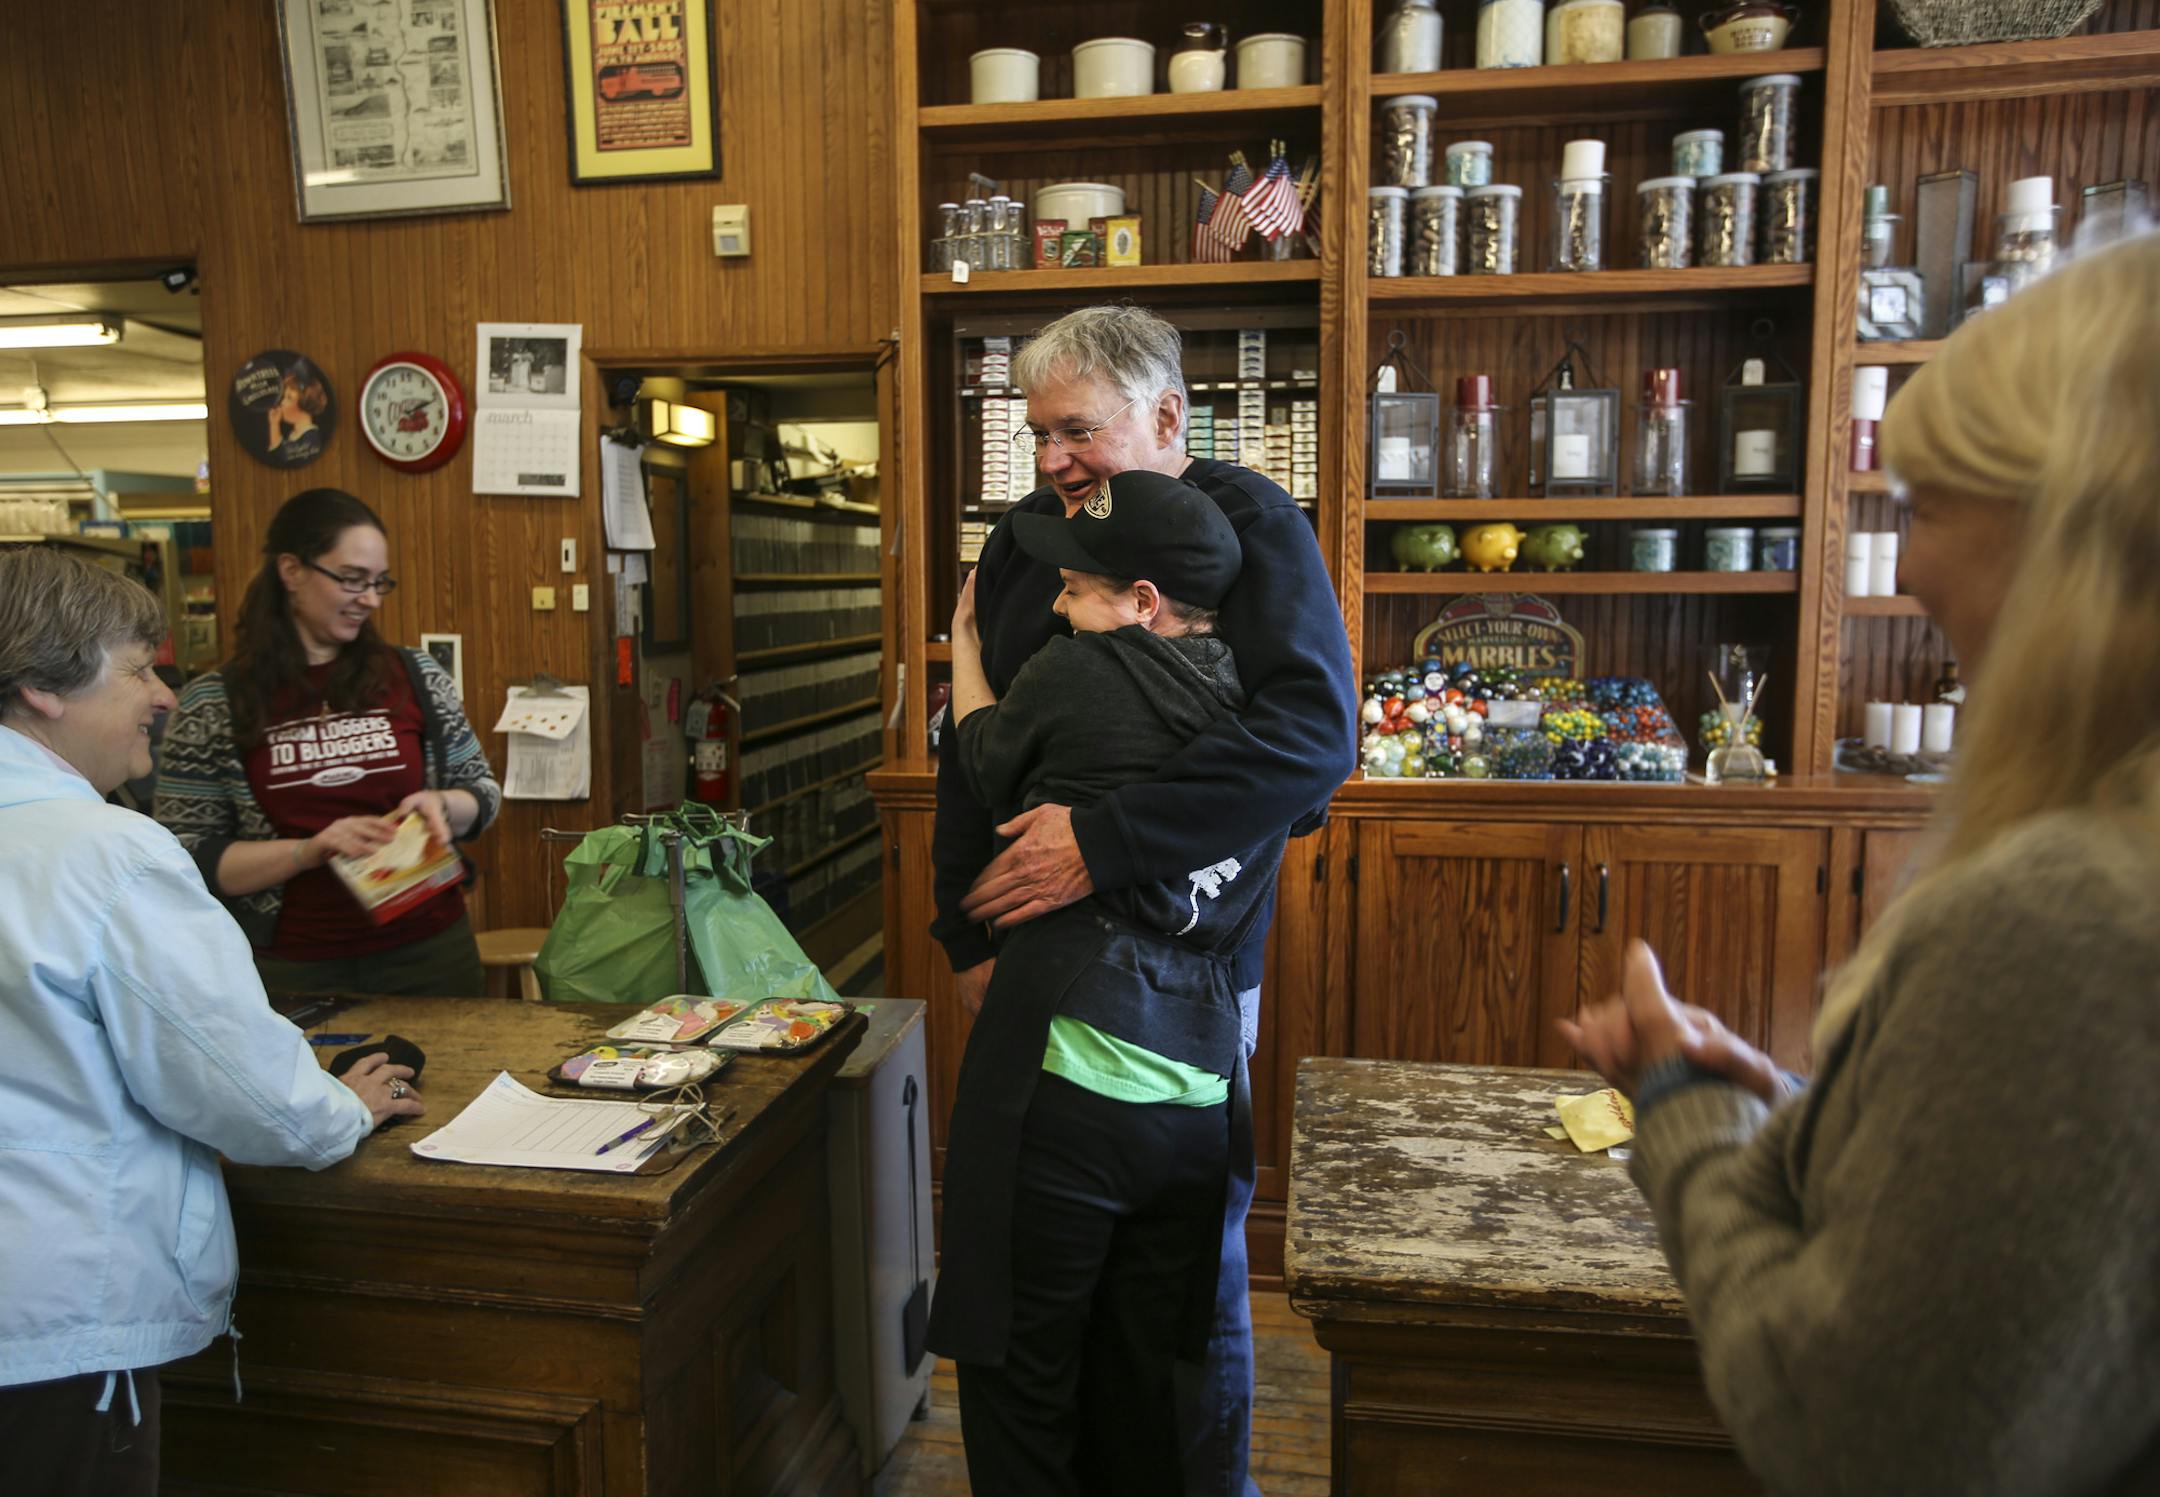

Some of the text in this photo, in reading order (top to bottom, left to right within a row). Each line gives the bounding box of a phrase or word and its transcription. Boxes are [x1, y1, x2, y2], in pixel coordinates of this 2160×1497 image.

[597, 15, 680, 45] BALL
[386, 379, 396, 388] 11
[400, 371, 412, 382] 12
[485, 410, 533, 425] march
[1442, 645, 1556, 669] MARBLES
[319, 716, 391, 740] LOGGERS
[271, 730, 397, 766] TO BLOGGERS
